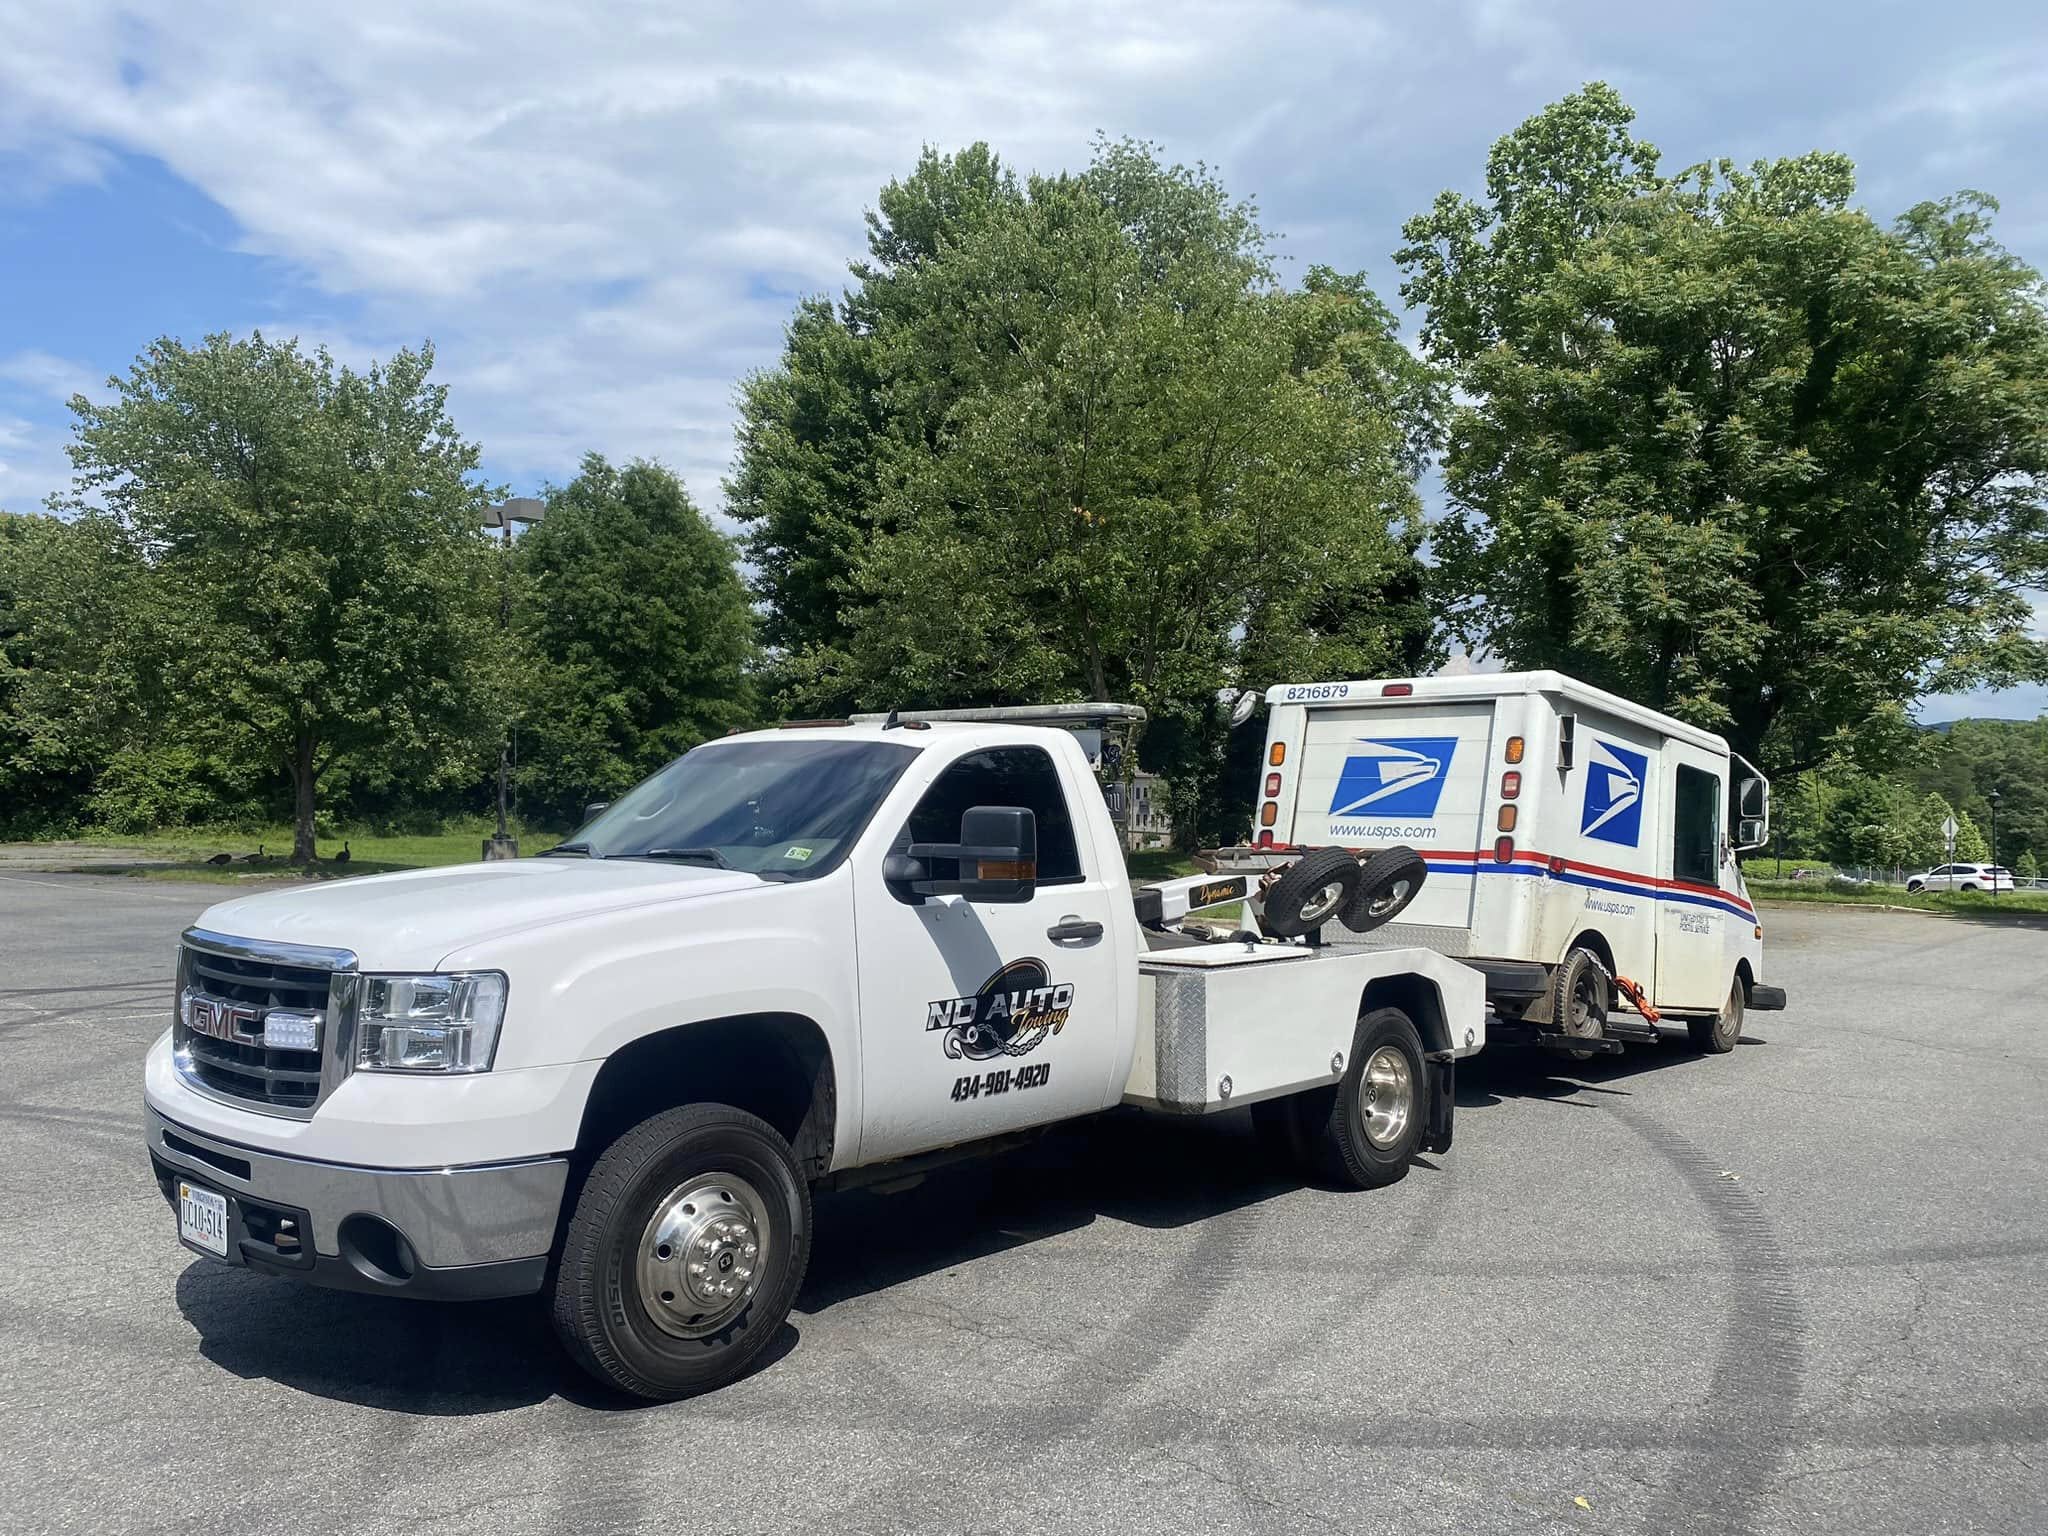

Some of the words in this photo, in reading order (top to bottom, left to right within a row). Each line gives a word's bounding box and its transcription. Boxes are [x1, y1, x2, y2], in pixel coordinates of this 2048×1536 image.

[1287, 684, 1349, 700] 8216879
[1330, 825, 1437, 840] www.usps.com
[1584, 899, 1636, 917] www.usps.com
[191, 997, 257, 1047] GMC
[926, 998, 977, 1031] ND
[985, 983, 1074, 1020] AUTO
[1011, 1005, 1069, 1035] Towing
[951, 1063, 1050, 1102] 434-981-4920
